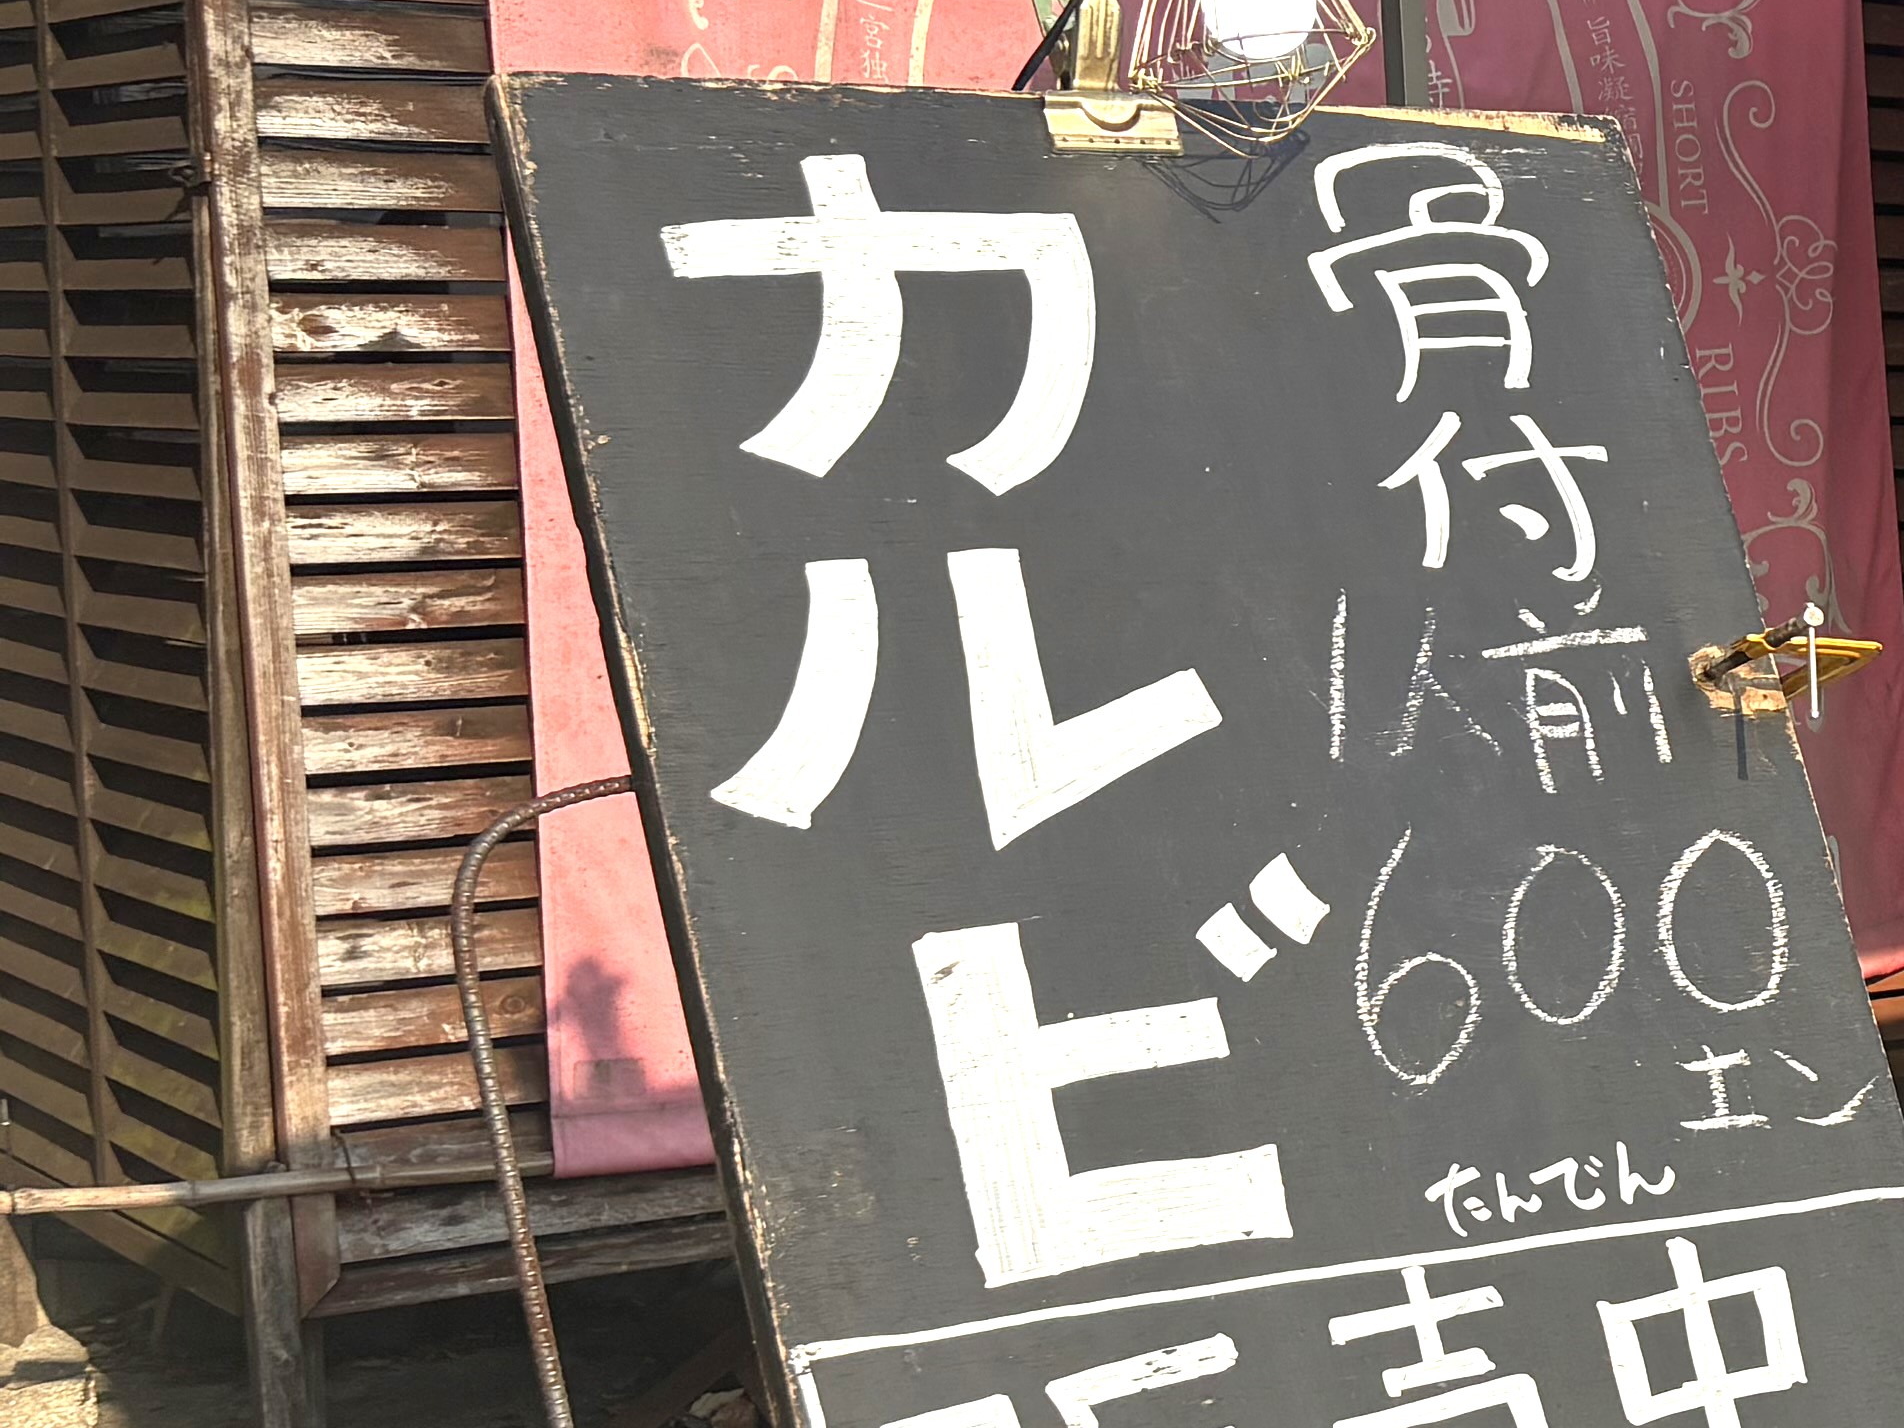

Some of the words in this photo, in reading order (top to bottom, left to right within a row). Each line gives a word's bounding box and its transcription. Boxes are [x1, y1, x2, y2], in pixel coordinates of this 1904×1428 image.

[1307, 141, 1609, 582] 骨付
[1671, 80, 1709, 216] SHORT
[1695, 342, 1748, 466] RIBS
[660, 153, 1330, 1287] カルビ
[1352, 824, 1789, 1086] 600
[1679, 1045, 1879, 1129] エン
[1424, 1140, 1676, 1237] たんでん
